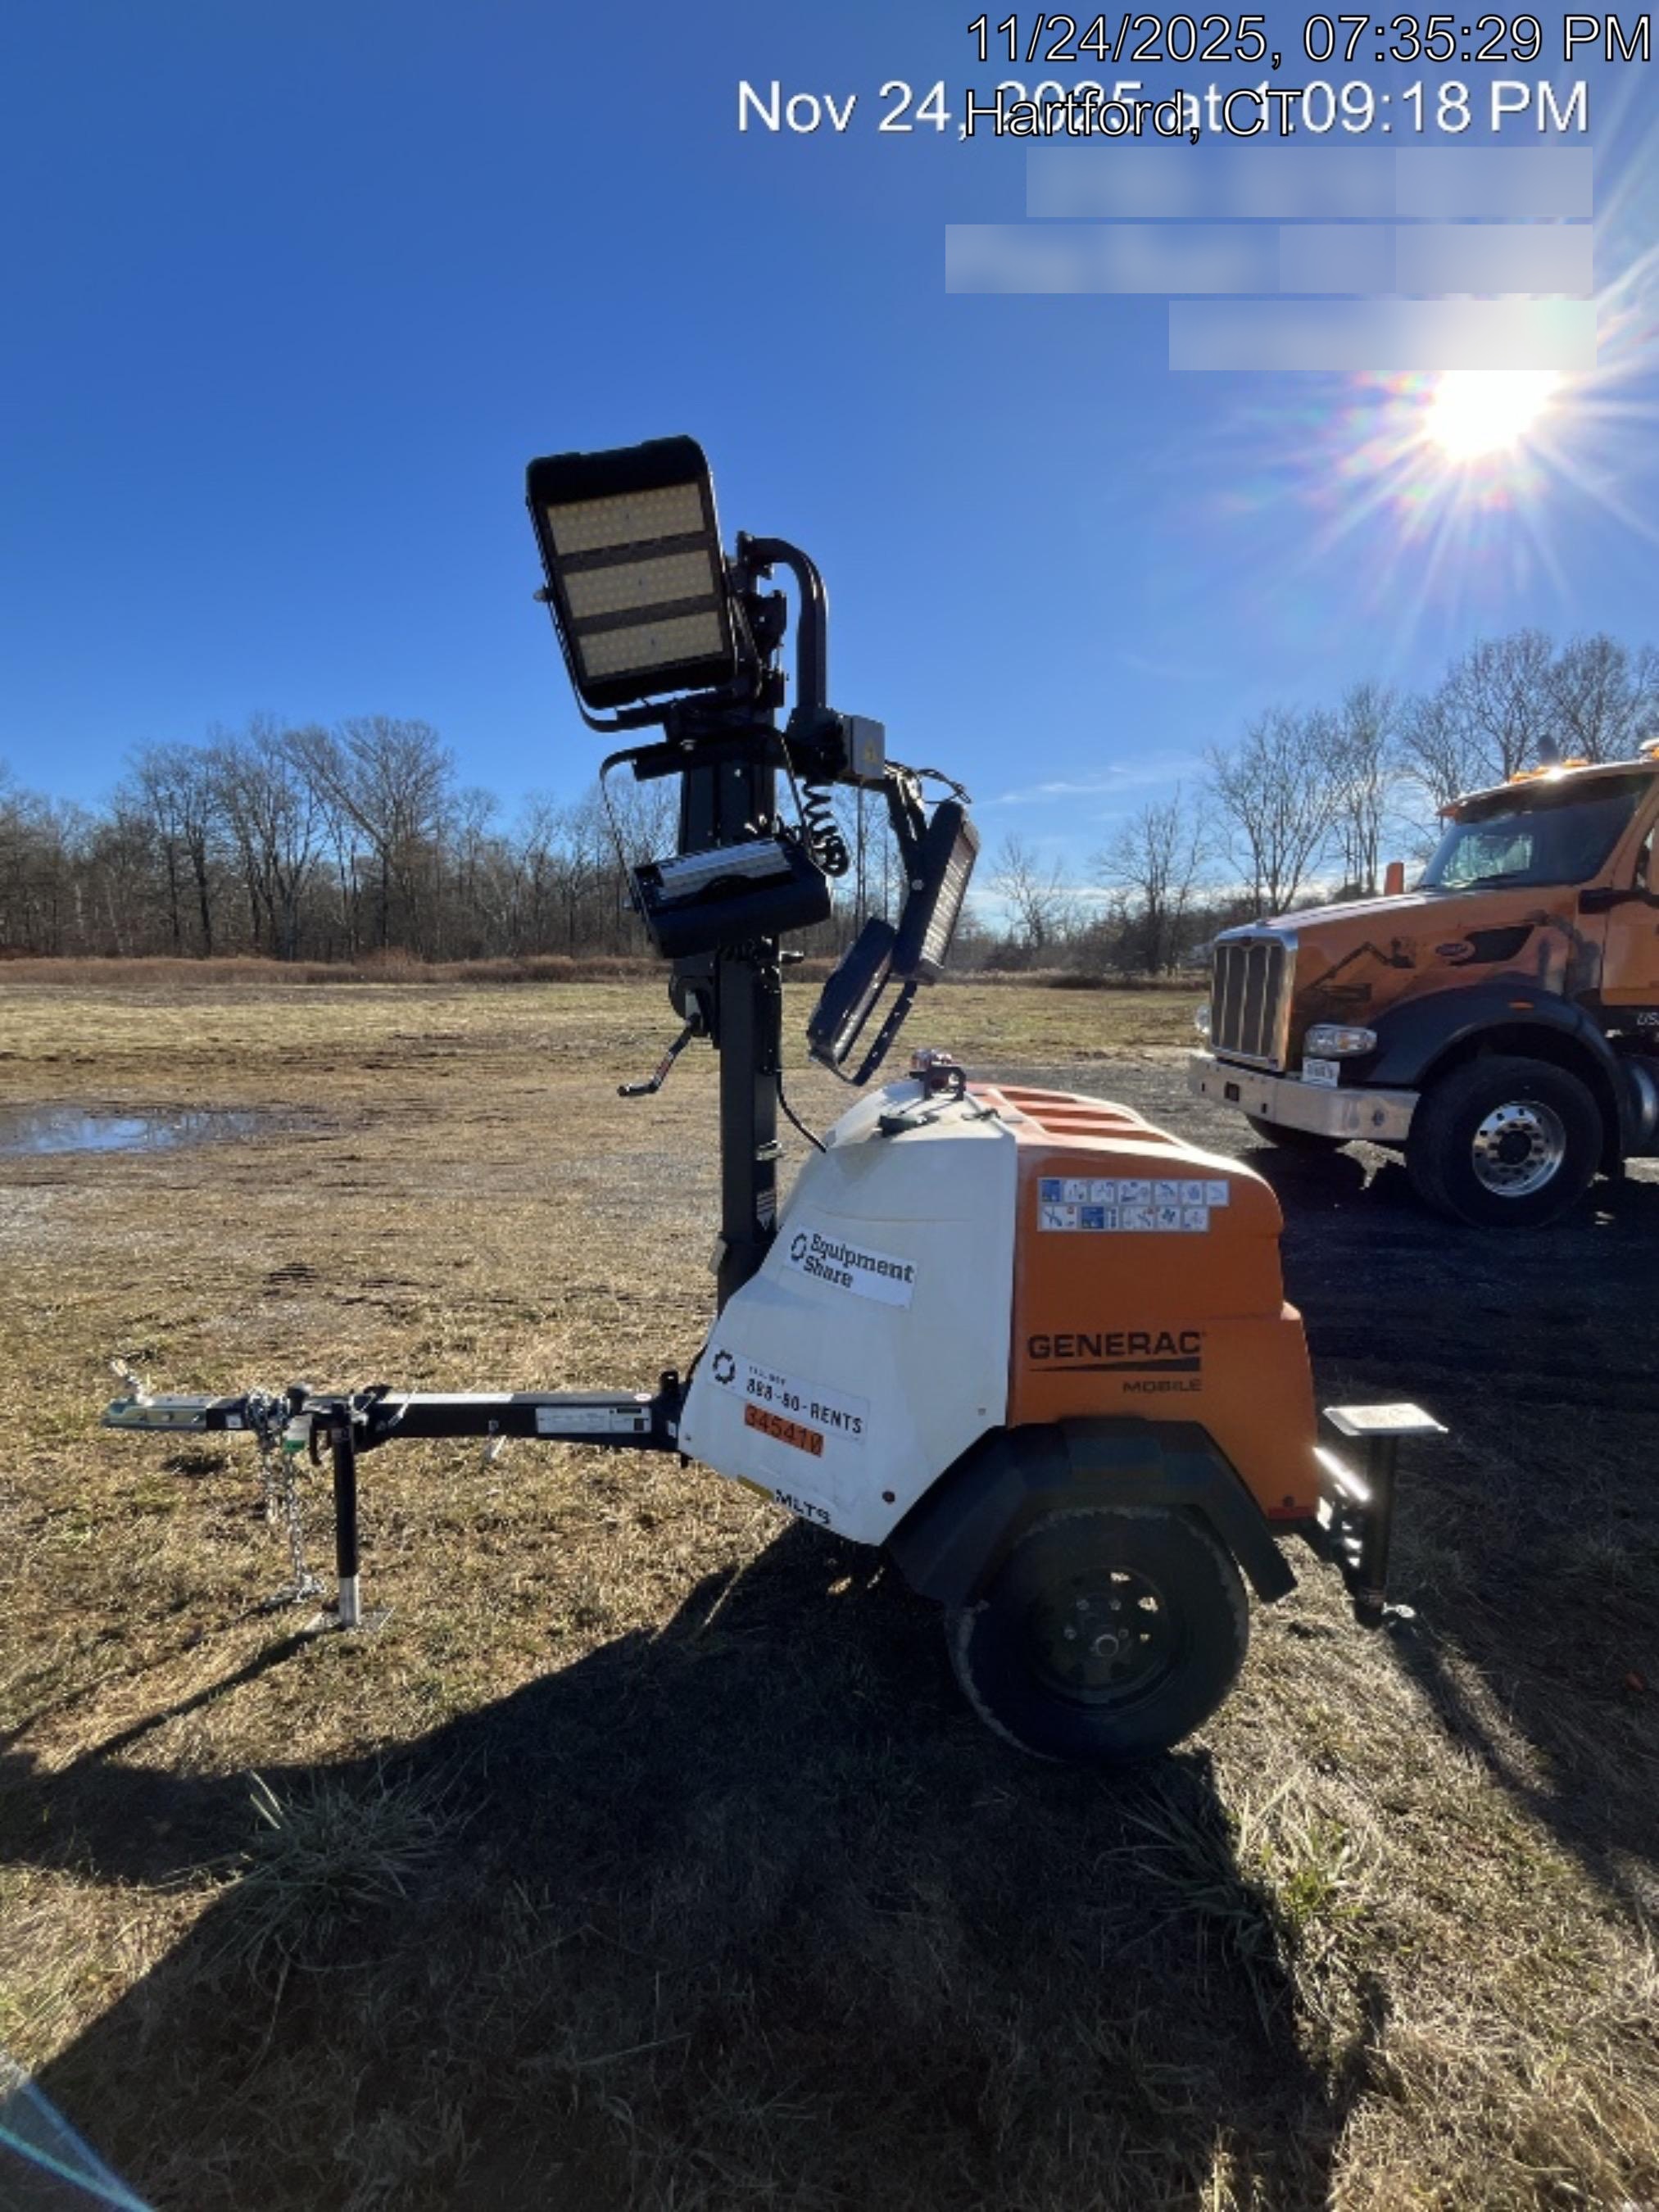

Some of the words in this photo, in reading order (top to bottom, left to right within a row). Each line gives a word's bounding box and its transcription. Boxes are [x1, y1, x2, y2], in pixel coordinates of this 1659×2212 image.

[803, 1255, 853, 1288] Share
[810, 1234, 914, 1284] Equipment
[1027, 1331, 1202, 1359] GENERAC
[1122, 1379, 1202, 1394] MOBILE
